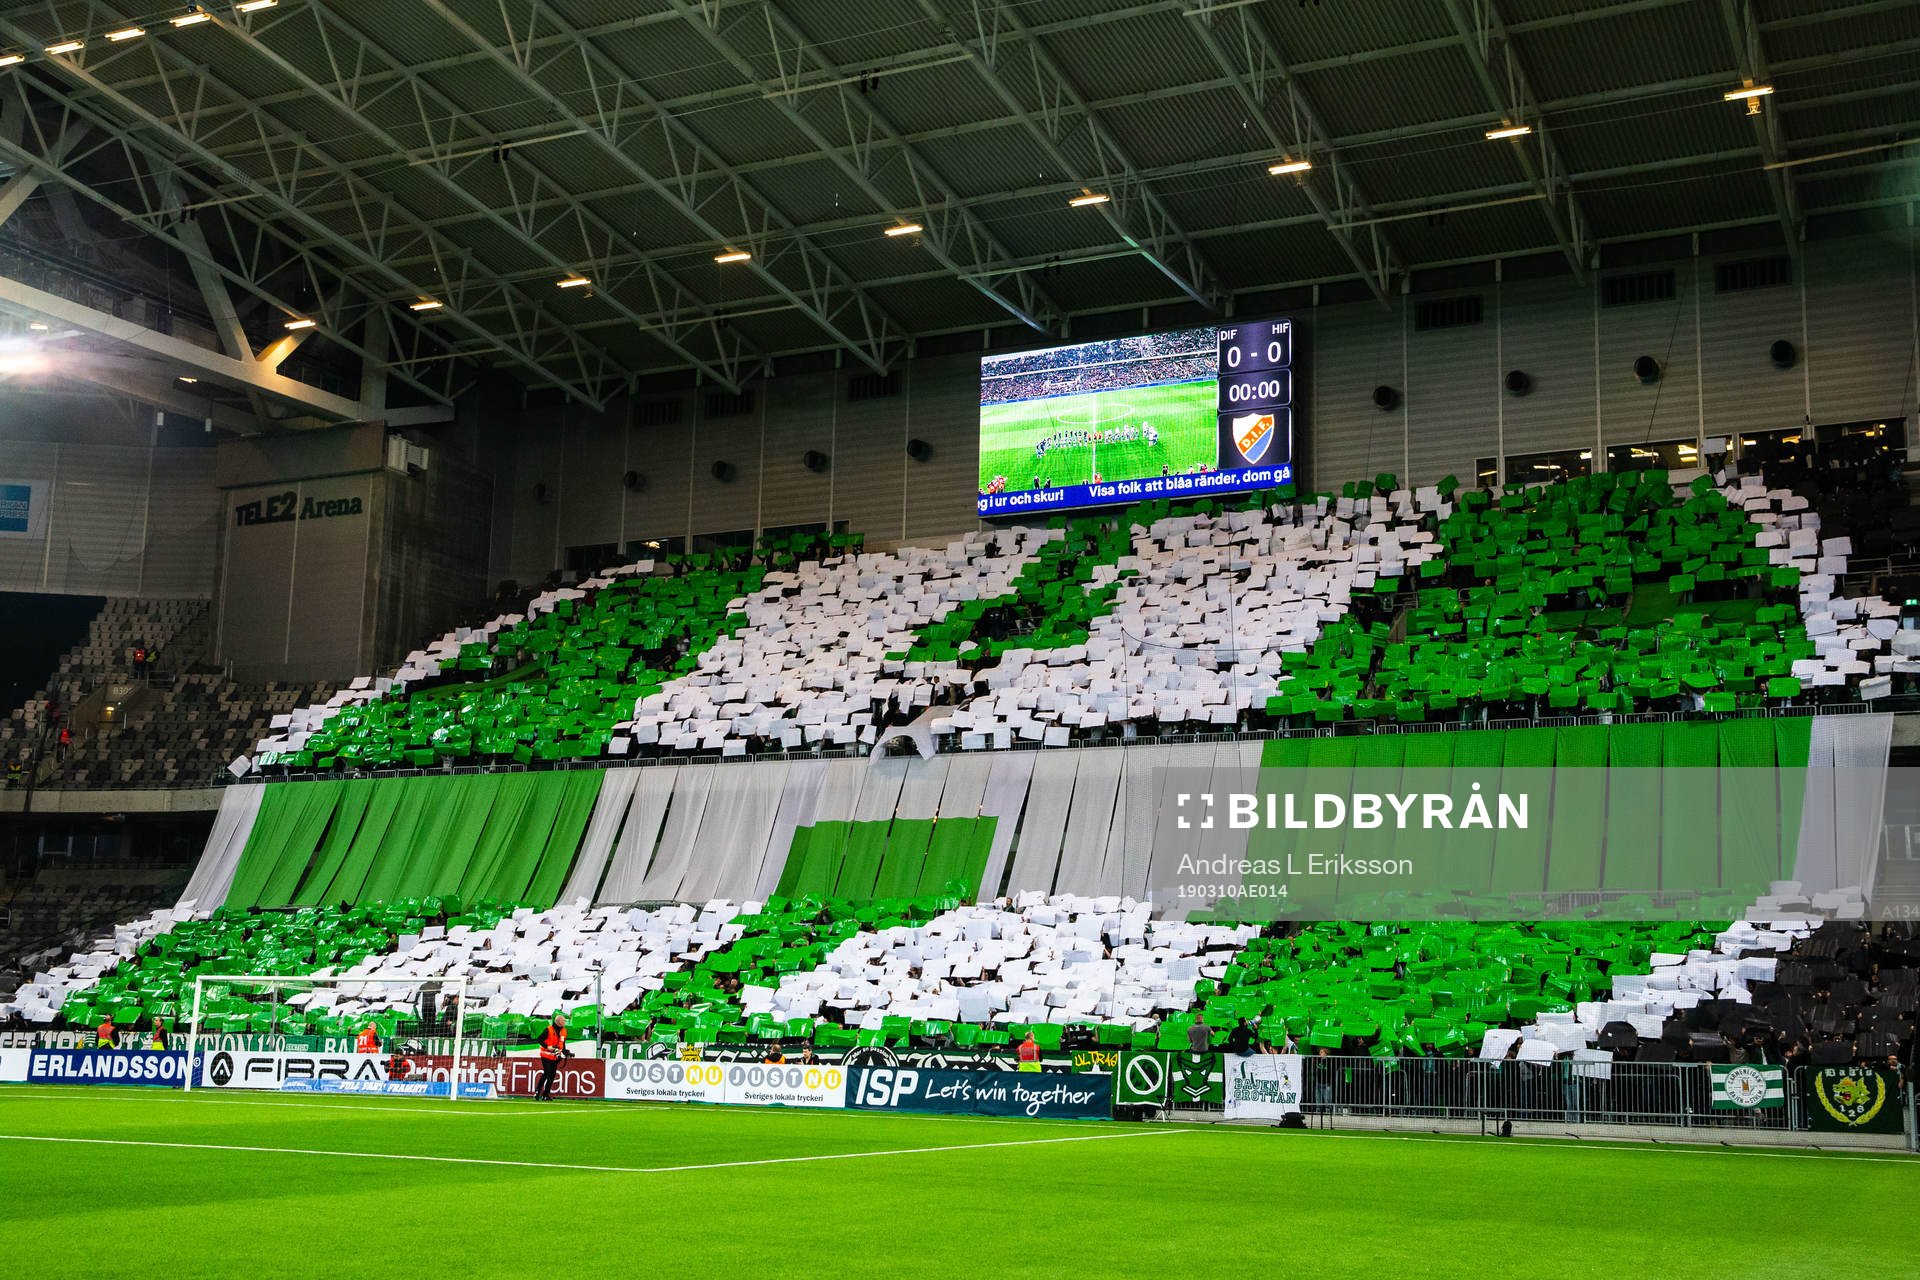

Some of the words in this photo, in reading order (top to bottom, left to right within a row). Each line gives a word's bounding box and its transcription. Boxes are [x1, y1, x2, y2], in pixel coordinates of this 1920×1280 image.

[1220, 329, 1238, 341] DIF
[1272, 322, 1290, 335] HIF
[1227, 346, 1241, 368] 0
[1267, 341, 1282, 363] 0
[1229, 380, 1280, 402] 00:00
[995, 496, 1007, 508] ur
[1010, 492, 1032, 506] och
[1033, 488, 1064, 504] skur!
[1089, 483, 1115, 498] Visa
[1117, 481, 1142, 496] folk
[1145, 479, 1163, 493] att
[1165, 474, 1193, 491] blåa
[1194, 472, 1241, 489] ränder,
[1242, 468, 1271, 484] dom
[1273, 465, 1291, 483] gå
[236, 490, 297, 526] TELE2
[299, 497, 362, 520] Arena
[32, 1054, 188, 1079] ERLANDSSON
[245, 1058, 381, 1082] FIBRA
[626, 1087, 655, 1096] Sveriges
[656, 1088, 677, 1096] lokala
[678, 1090, 705, 1098] tryckeri
[744, 1092, 774, 1101] Sveriges
[774, 1092, 796, 1101] lokala
[797, 1094, 824, 1103] tryckeri
[855, 1068, 919, 1106] ISP
[925, 1079, 971, 1100] Let's
[975, 1081, 1006, 1101] win
[1012, 1082, 1095, 1116] together
[1234, 1090, 1297, 1104] GROTTAN
